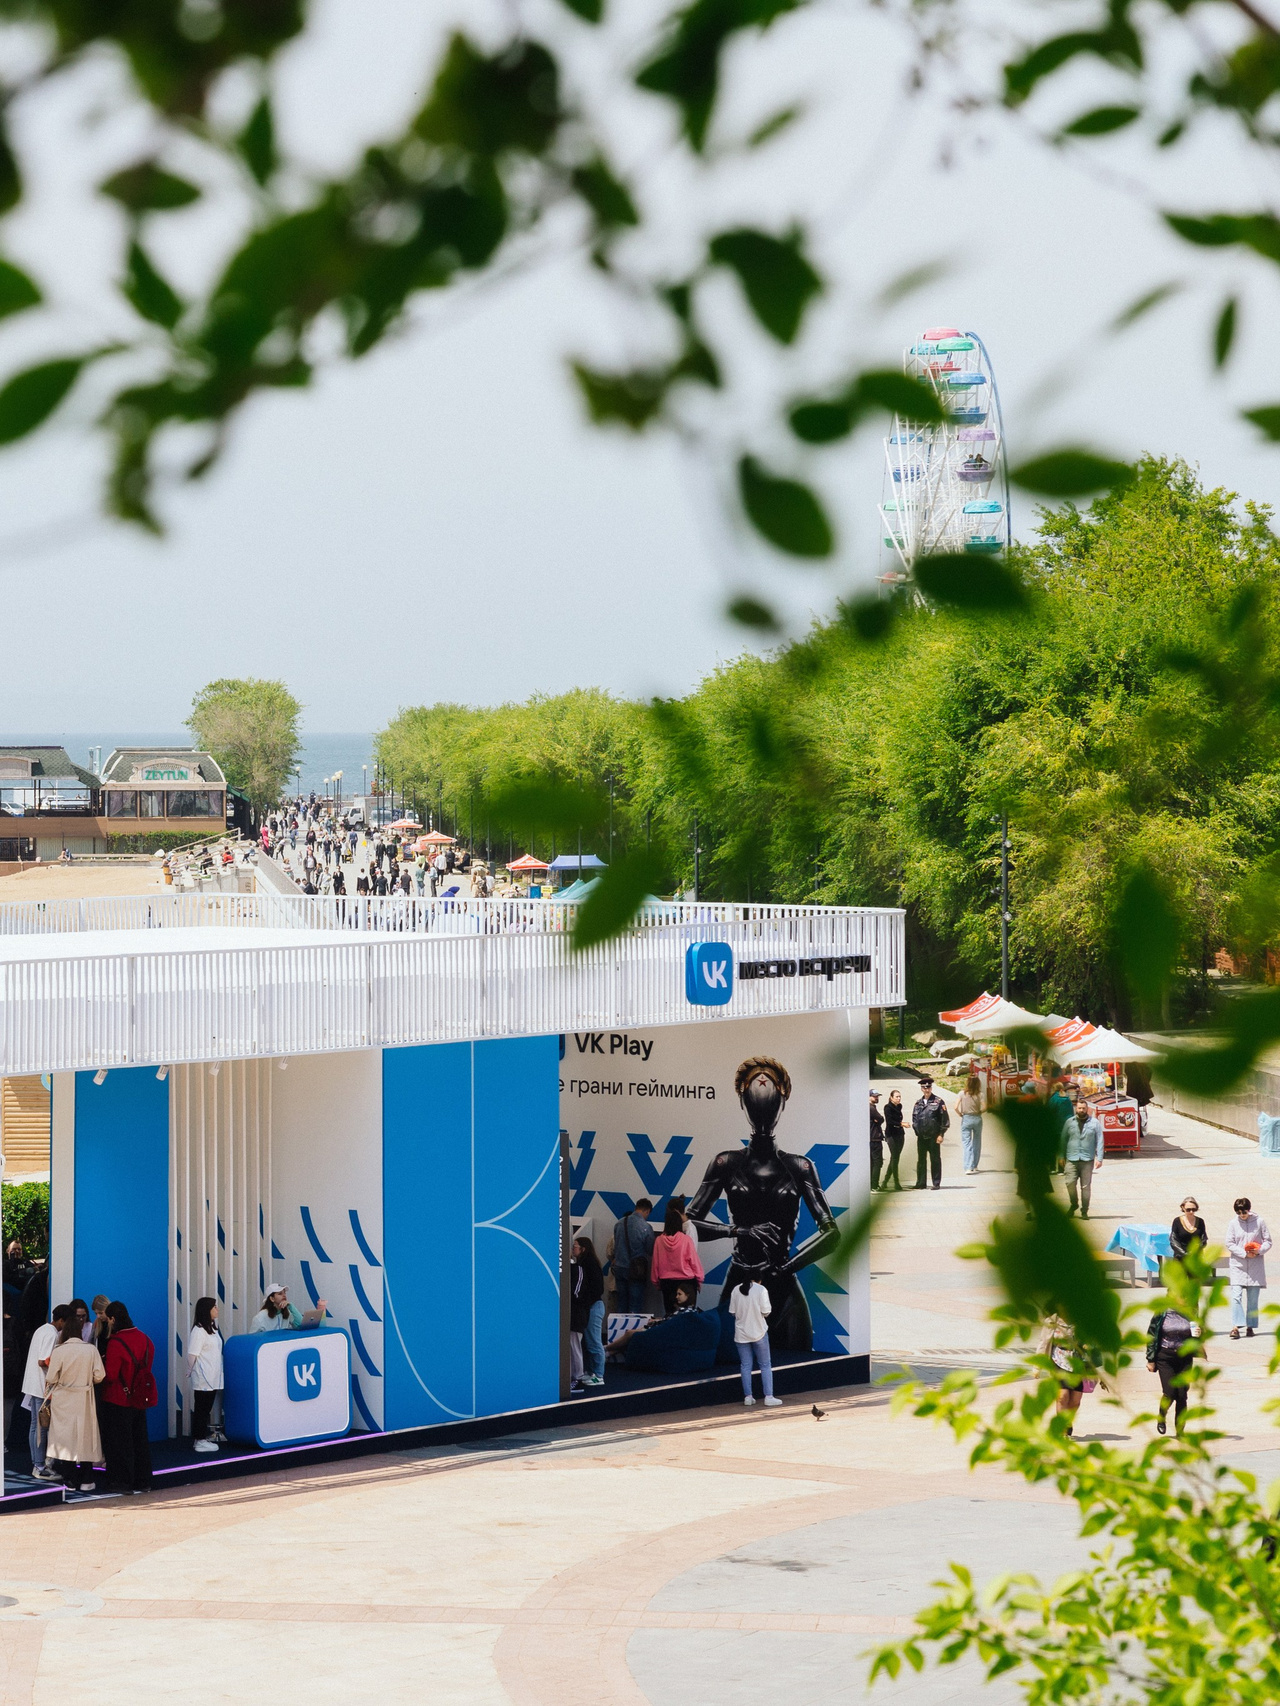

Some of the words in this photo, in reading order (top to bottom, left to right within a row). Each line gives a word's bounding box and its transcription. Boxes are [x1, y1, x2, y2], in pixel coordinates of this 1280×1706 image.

[145, 769, 188, 780] ZEYTUN
[702, 960, 728, 989] VK
[739, 960, 797, 980] место
[799, 955, 871, 981] встречи
[574, 1033, 605, 1054] VK
[610, 1034, 654, 1061] Play
[570, 1080, 623, 1098] грани
[628, 1079, 716, 1100] гейминга
[293, 1363, 317, 1387] VK
